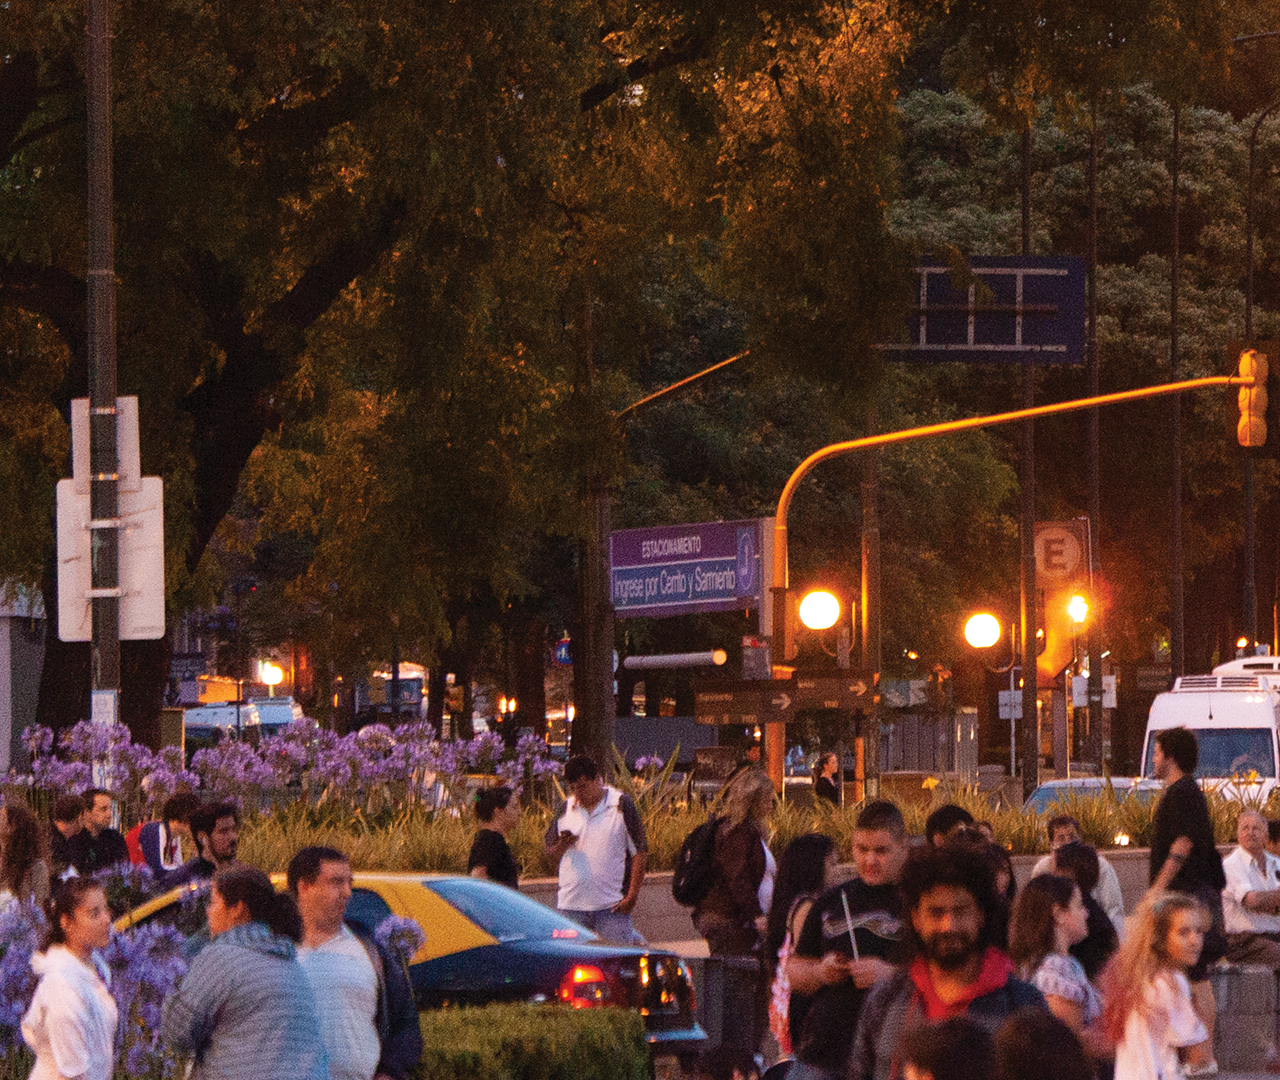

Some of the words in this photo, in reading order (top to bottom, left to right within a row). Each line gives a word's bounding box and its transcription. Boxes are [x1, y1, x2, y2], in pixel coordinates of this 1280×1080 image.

[642, 535, 701, 558] ESTACIONAMIENTO
[1044, 538, 1067, 569] E
[614, 575, 643, 604] Ingrese
[645, 576, 659, 602] por
[688, 574, 694, 598] y
[695, 566, 736, 591] Sarmiento
